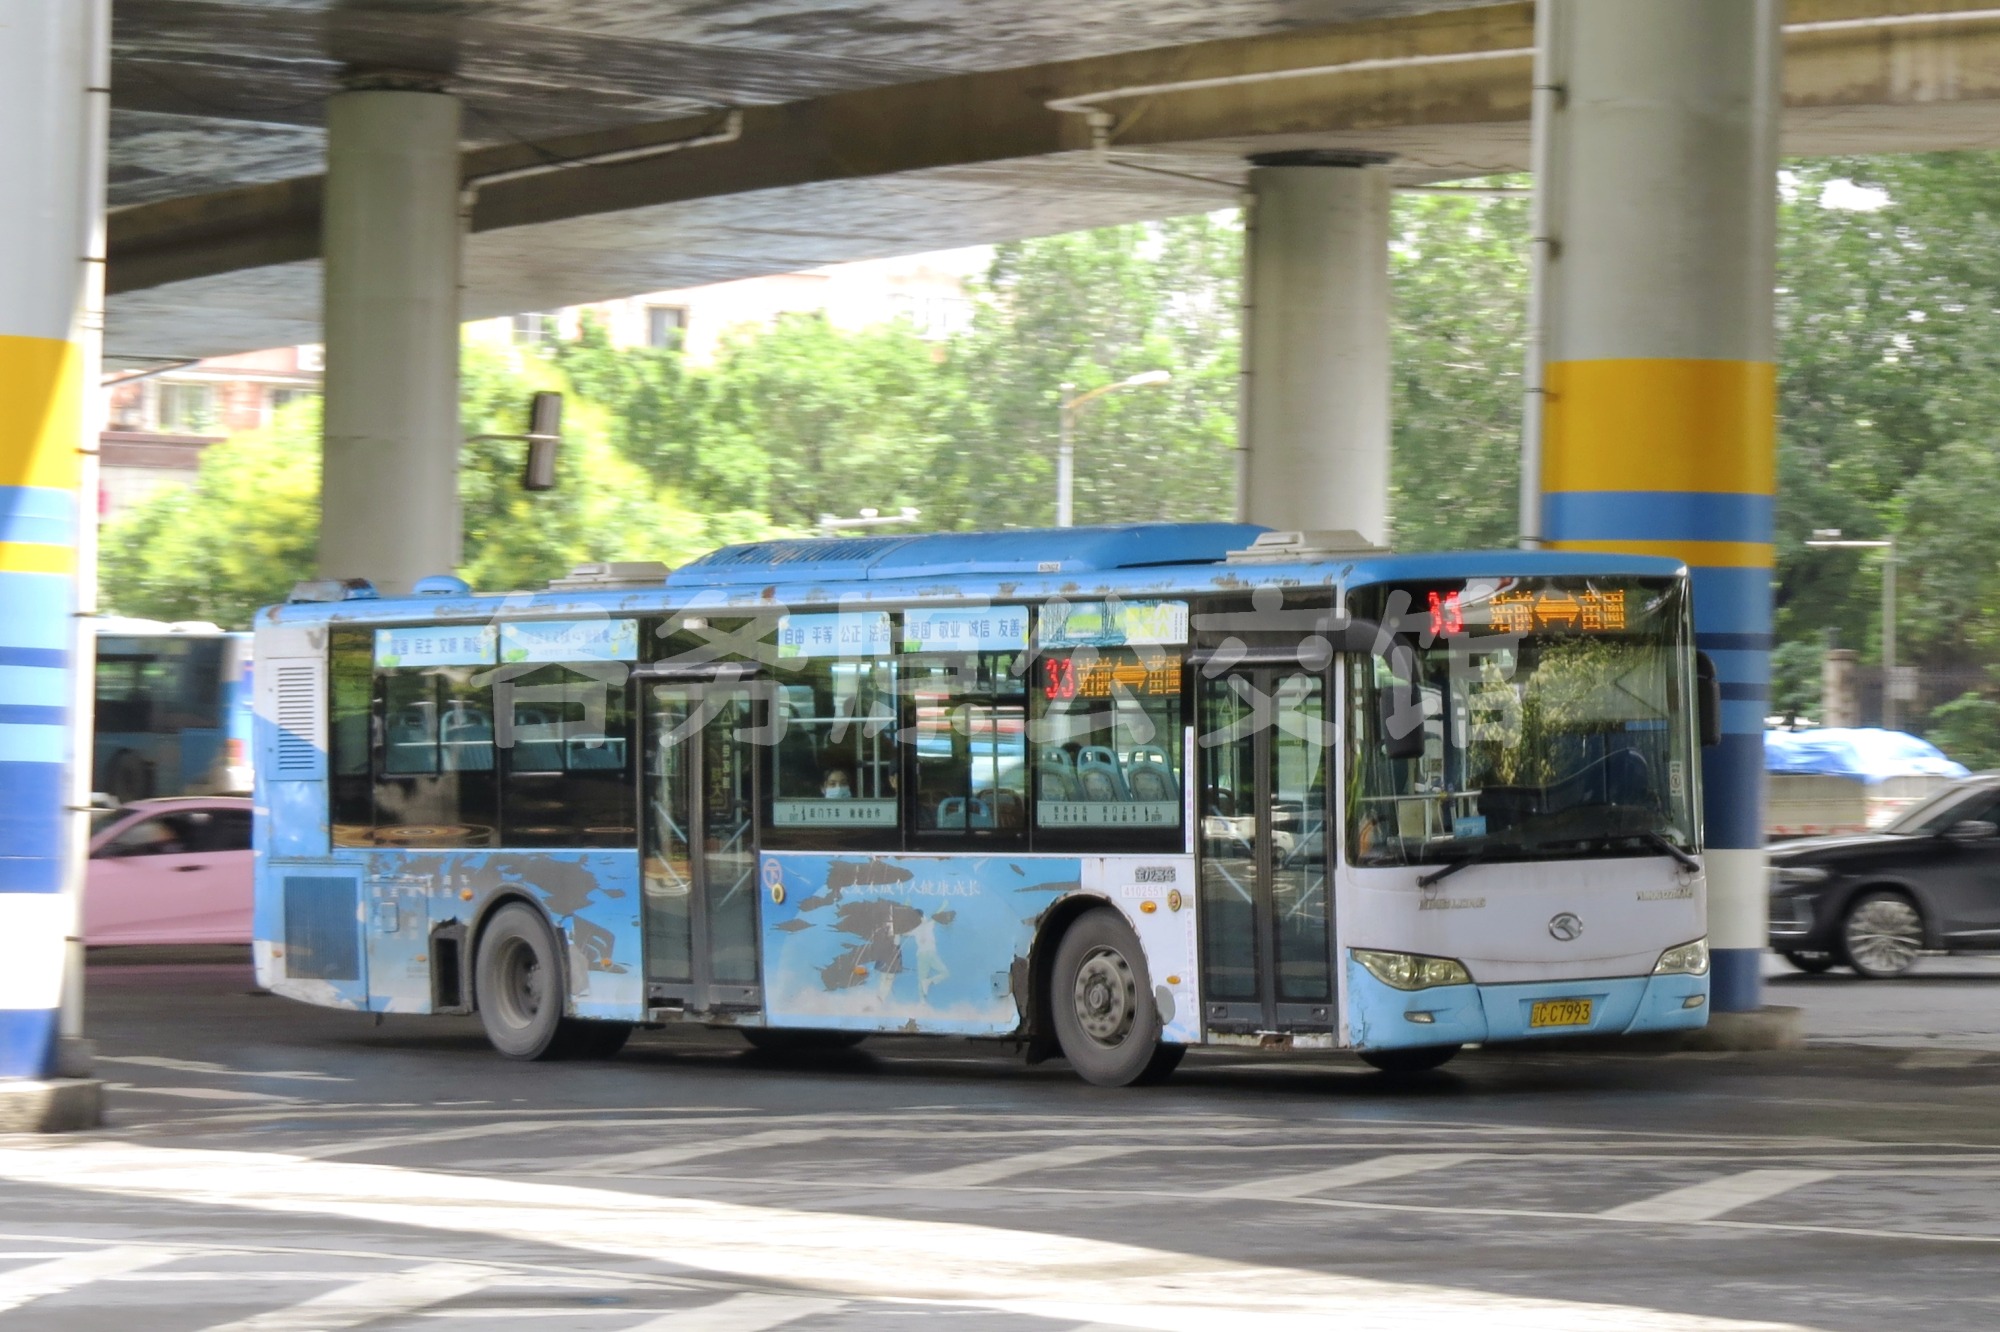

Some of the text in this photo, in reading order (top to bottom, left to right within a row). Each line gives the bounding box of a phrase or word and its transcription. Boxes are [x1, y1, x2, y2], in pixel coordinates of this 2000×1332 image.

[1427, 591, 1464, 633] 33
[784, 624, 892, 645] 自由 平等 公正 法治
[909, 617, 1020, 640] 爱国 敬业 诚信 友善
[1045, 657, 1075, 699] 33
